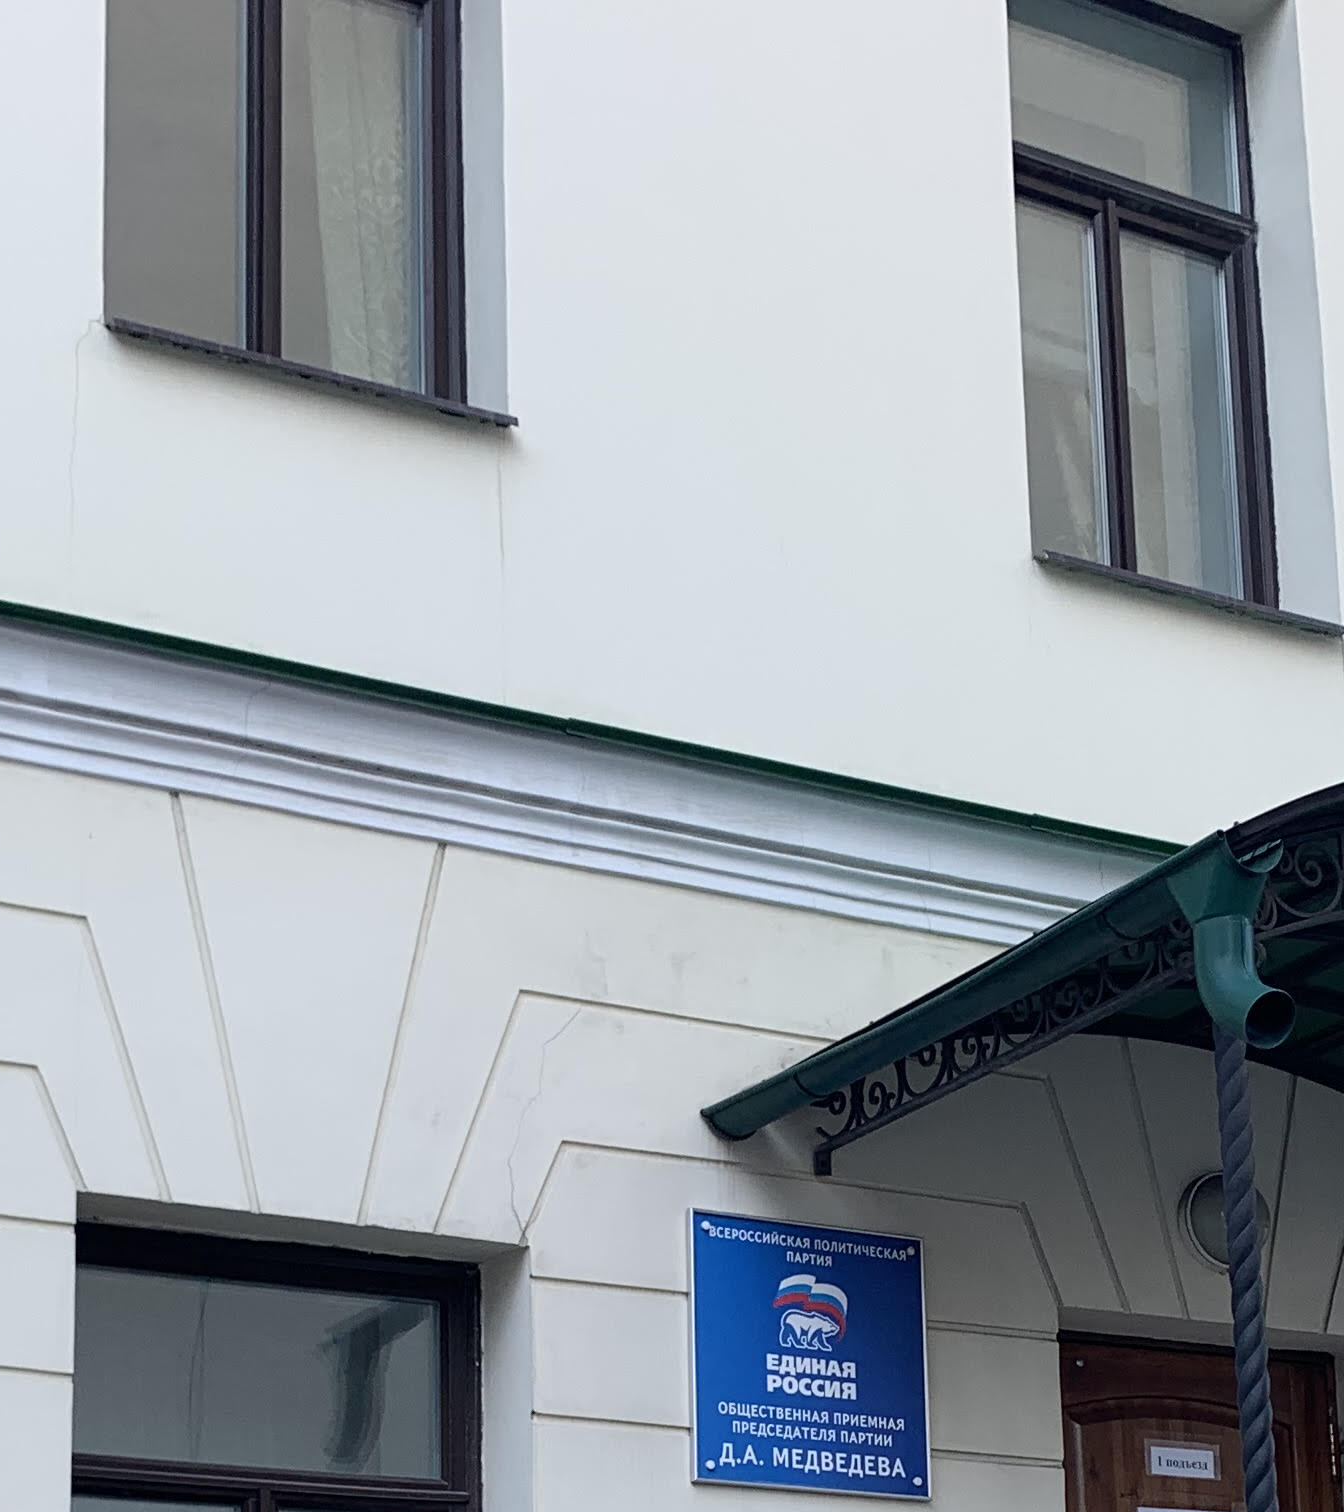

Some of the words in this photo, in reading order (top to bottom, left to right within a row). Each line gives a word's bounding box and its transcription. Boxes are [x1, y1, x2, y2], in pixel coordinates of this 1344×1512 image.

[709, 1225, 811, 1249] ВСЕРОССИЙСКАЯ
[814, 1239, 907, 1261] ПОЛИТИЧЕСКАЯ
[786, 1251, 833, 1267] ПАРТИЯ
[766, 1353, 856, 1379] ЕДИНАЯ
[766, 1374, 857, 1400] РОССИЯ
[718, 1401, 829, 1424] ОБЩЕСТВЕННАЯ
[833, 1412, 905, 1431] ПРИЕМНАЯ
[732, 1420, 837, 1443] ПРЕДСЕДАТЕЛЯ
[840, 1431, 893, 1447] ПАРТИИ
[719, 1442, 764, 1467] Д.А.
[772, 1447, 906, 1478] МЕДВЕДЕВА
